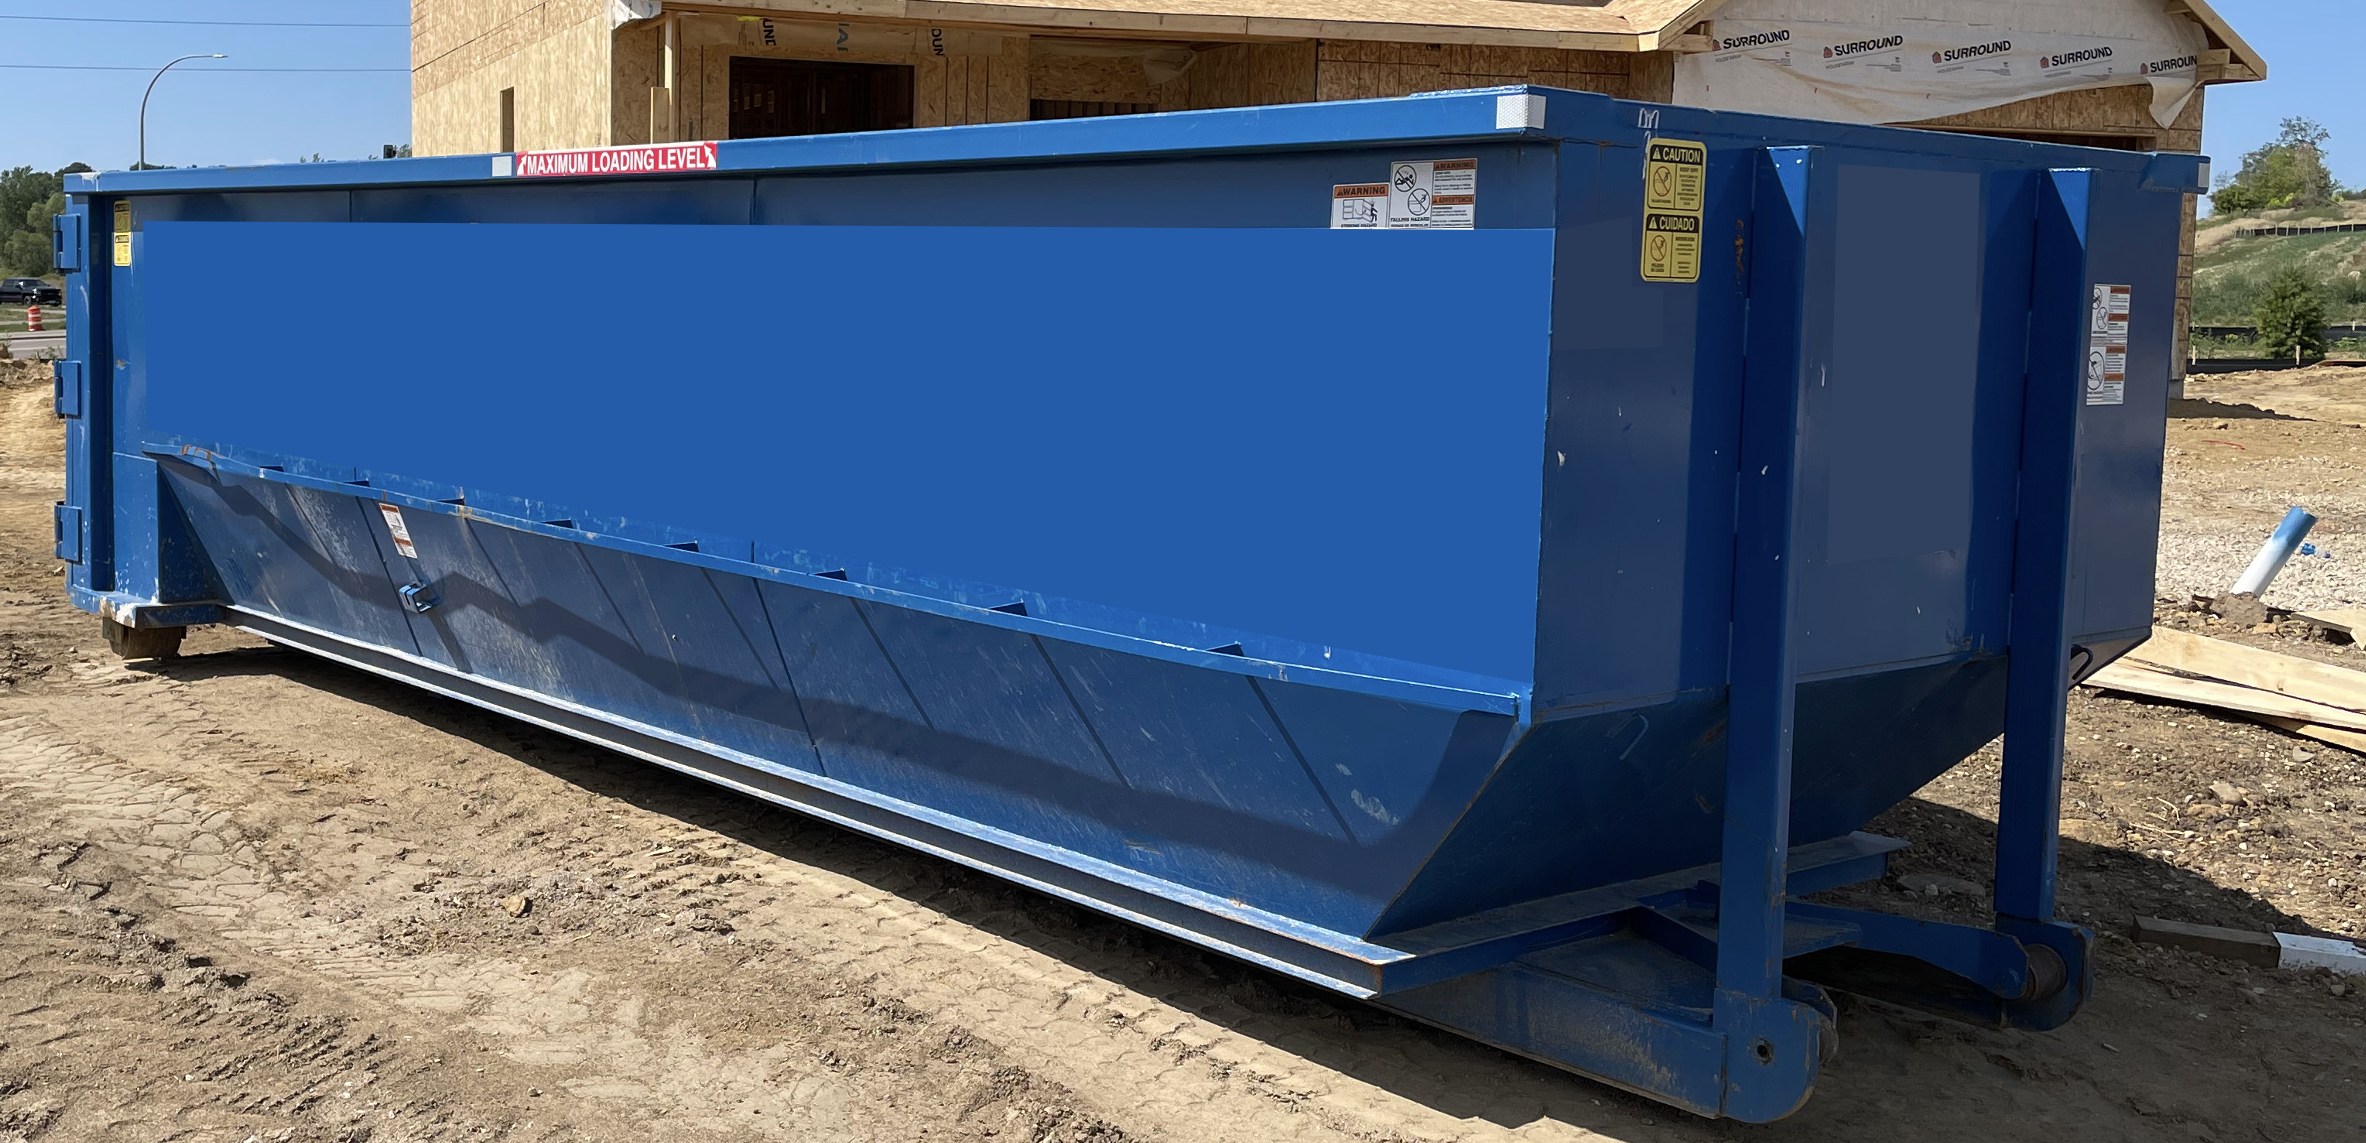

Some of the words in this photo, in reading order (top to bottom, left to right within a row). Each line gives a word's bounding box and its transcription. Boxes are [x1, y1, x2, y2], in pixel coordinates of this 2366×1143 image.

[1723, 30, 1790, 49] SURROUND
[1834, 35, 1903, 56] SURROUND
[1944, 40, 2011, 62] SURROUND
[2051, 46, 2113, 66] SURROUND
[527, 152, 588, 175] MAXIMUM
[592, 149, 654, 172] LOADING
[658, 147, 705, 169] LEVEL
[1663, 147, 1700, 163] CAUTION
[1343, 186, 1386, 196] WARNING
[1660, 216, 1695, 231] CUIDADO
